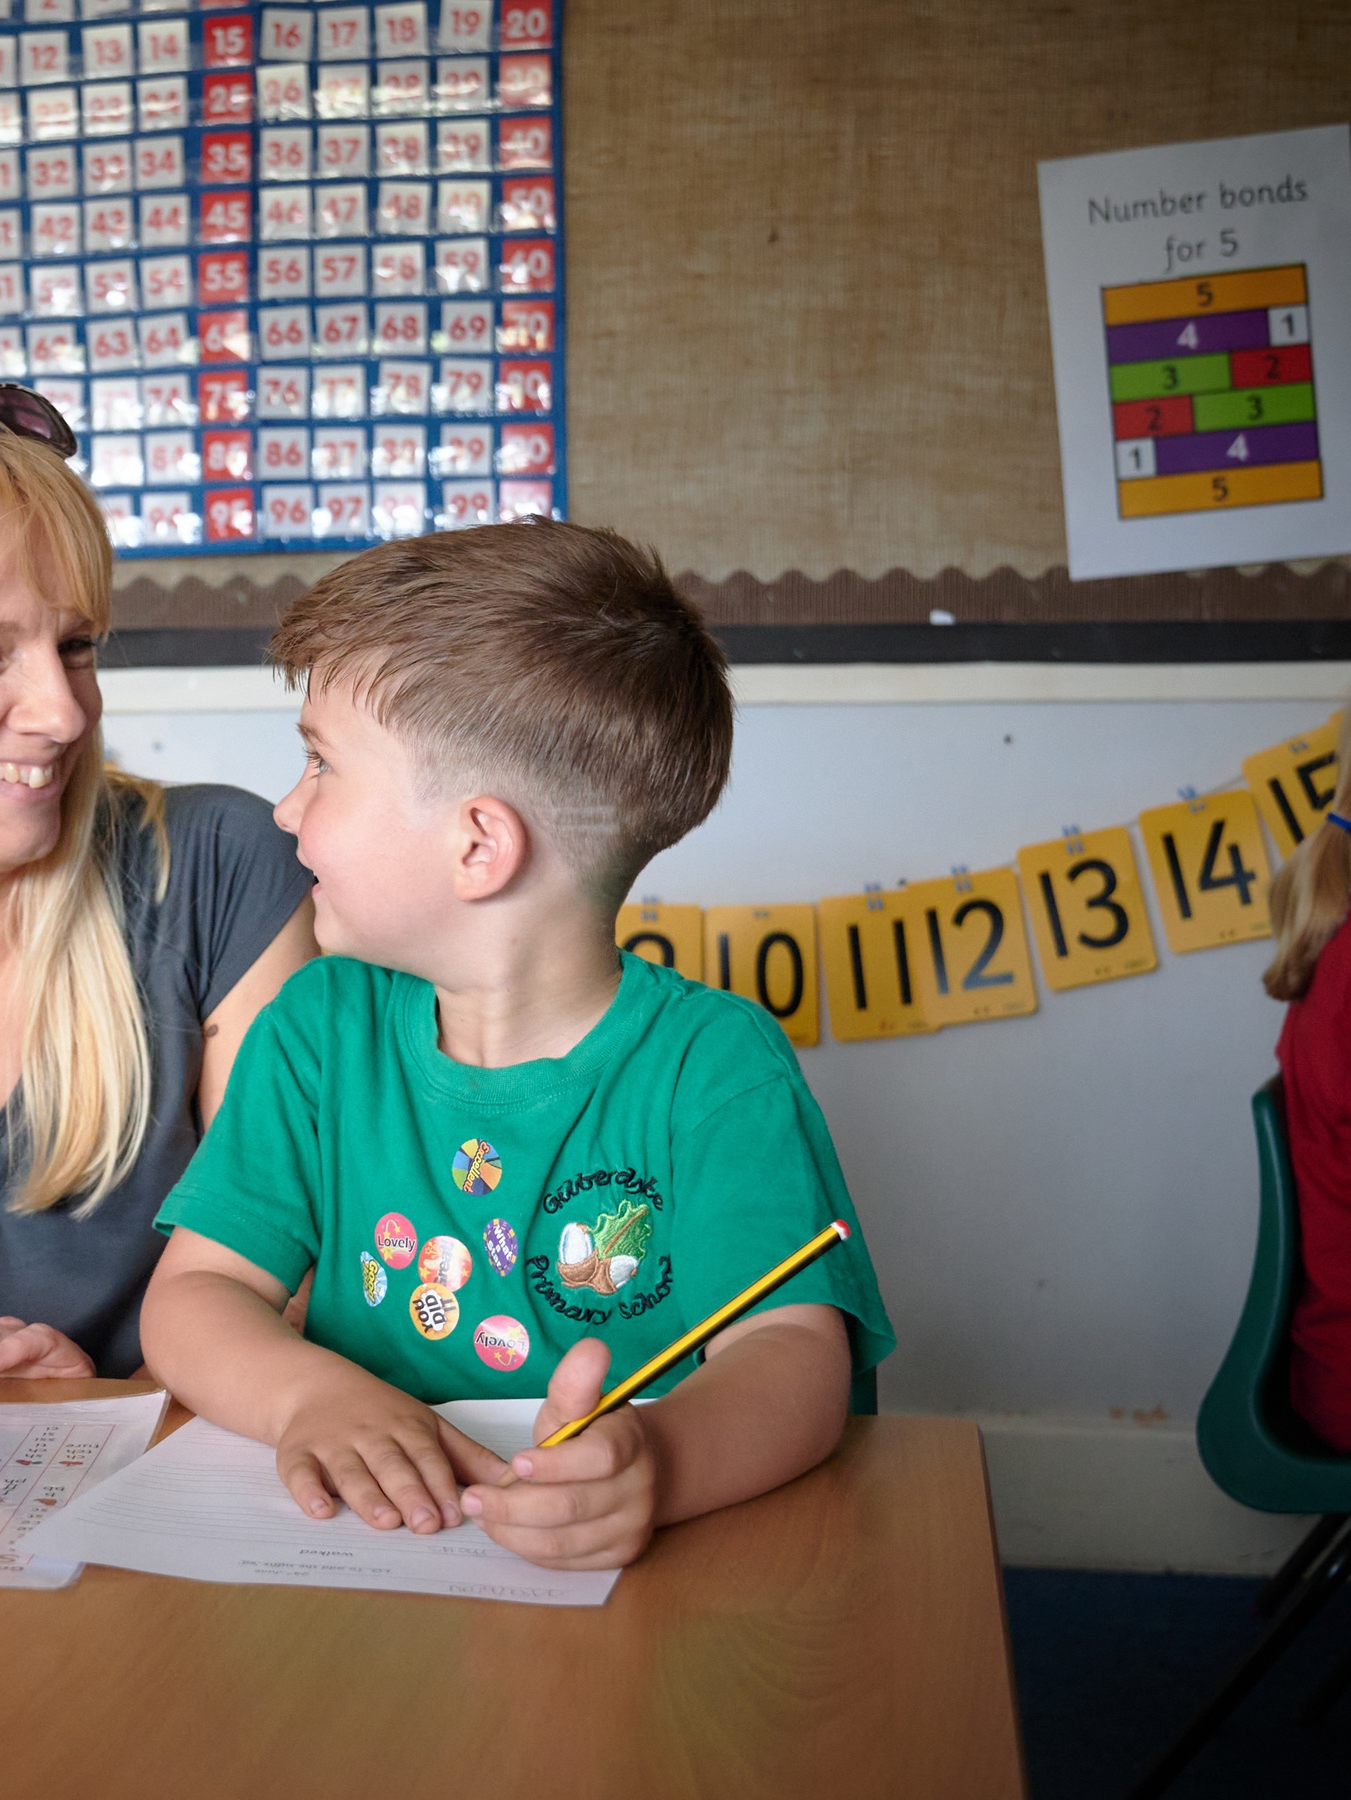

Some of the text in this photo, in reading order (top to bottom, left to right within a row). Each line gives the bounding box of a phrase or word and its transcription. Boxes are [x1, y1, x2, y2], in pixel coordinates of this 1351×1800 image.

[30, 46, 57, 72] 12
[93, 39, 123, 65] 13
[150, 34, 179, 61] 14
[212, 25, 246, 54] 15
[273, 22, 301, 48] 16
[330, 21, 358, 48] 17
[386, 17, 416, 43] 18
[451, 10, 480, 36] 19
[507, 9, 546, 38] 20
[264, 78, 300, 105] 26
[35, 160, 69, 187] 32
[90, 155, 124, 182] 33
[141, 150, 176, 177] 34
[207, 142, 247, 172] 35
[267, 140, 303, 167] 36
[325, 137, 360, 164] 37
[445, 134, 480, 161] 39
[39, 215, 73, 242] 42
[91, 209, 126, 235] 43
[147, 205, 182, 231] 44
[205, 200, 246, 227] 45
[267, 199, 303, 224] 46
[323, 195, 358, 221] 47
[385, 193, 421, 220] 48
[1087, 174, 1310, 226] Number bonds
[1164, 229, 1240, 273] for 5
[148, 267, 184, 295] 54
[204, 261, 242, 291] 55
[266, 258, 302, 284] 56
[322, 255, 357, 282] 57
[381, 254, 417, 281] 58
[1196, 282, 1214, 307] 5
[94, 330, 129, 358] 63
[145, 326, 180, 355] 64
[266, 320, 303, 346] 66
[324, 316, 359, 343] 67
[381, 315, 419, 341] 68
[451, 315, 487, 341] 69
[1176, 313, 1295, 350] 4 1
[265, 379, 300, 405] 76
[448, 370, 483, 396] 79
[1162, 355, 1280, 390] 3 2
[1146, 396, 1264, 432] 2 3
[266, 440, 303, 467] 86
[1128, 433, 1250, 470] 1 4
[1212, 476, 1229, 501] 5
[269, 498, 306, 525] 96
[327, 496, 362, 524] 97
[718, 930, 805, 1018] 10
[847, 917, 915, 1011] 11
[926, 898, 1015, 996] 12
[1039, 858, 1130, 958] 13
[1161, 818, 1257, 920] 14
[463, 1140, 490, 1194] Excellent
[378, 1235, 416, 1253] Lovely
[487, 1239, 502, 1268] Star
[494, 1224, 513, 1261] What
[440, 1298, 457, 1313] IT
[526, 1254, 613, 1325] Primary
[412, 1299, 433, 1334] YOU
[425, 1294, 446, 1326] DID
[476, 1331, 527, 1353] Lovely
[299, 1549, 354, 1557] walked
